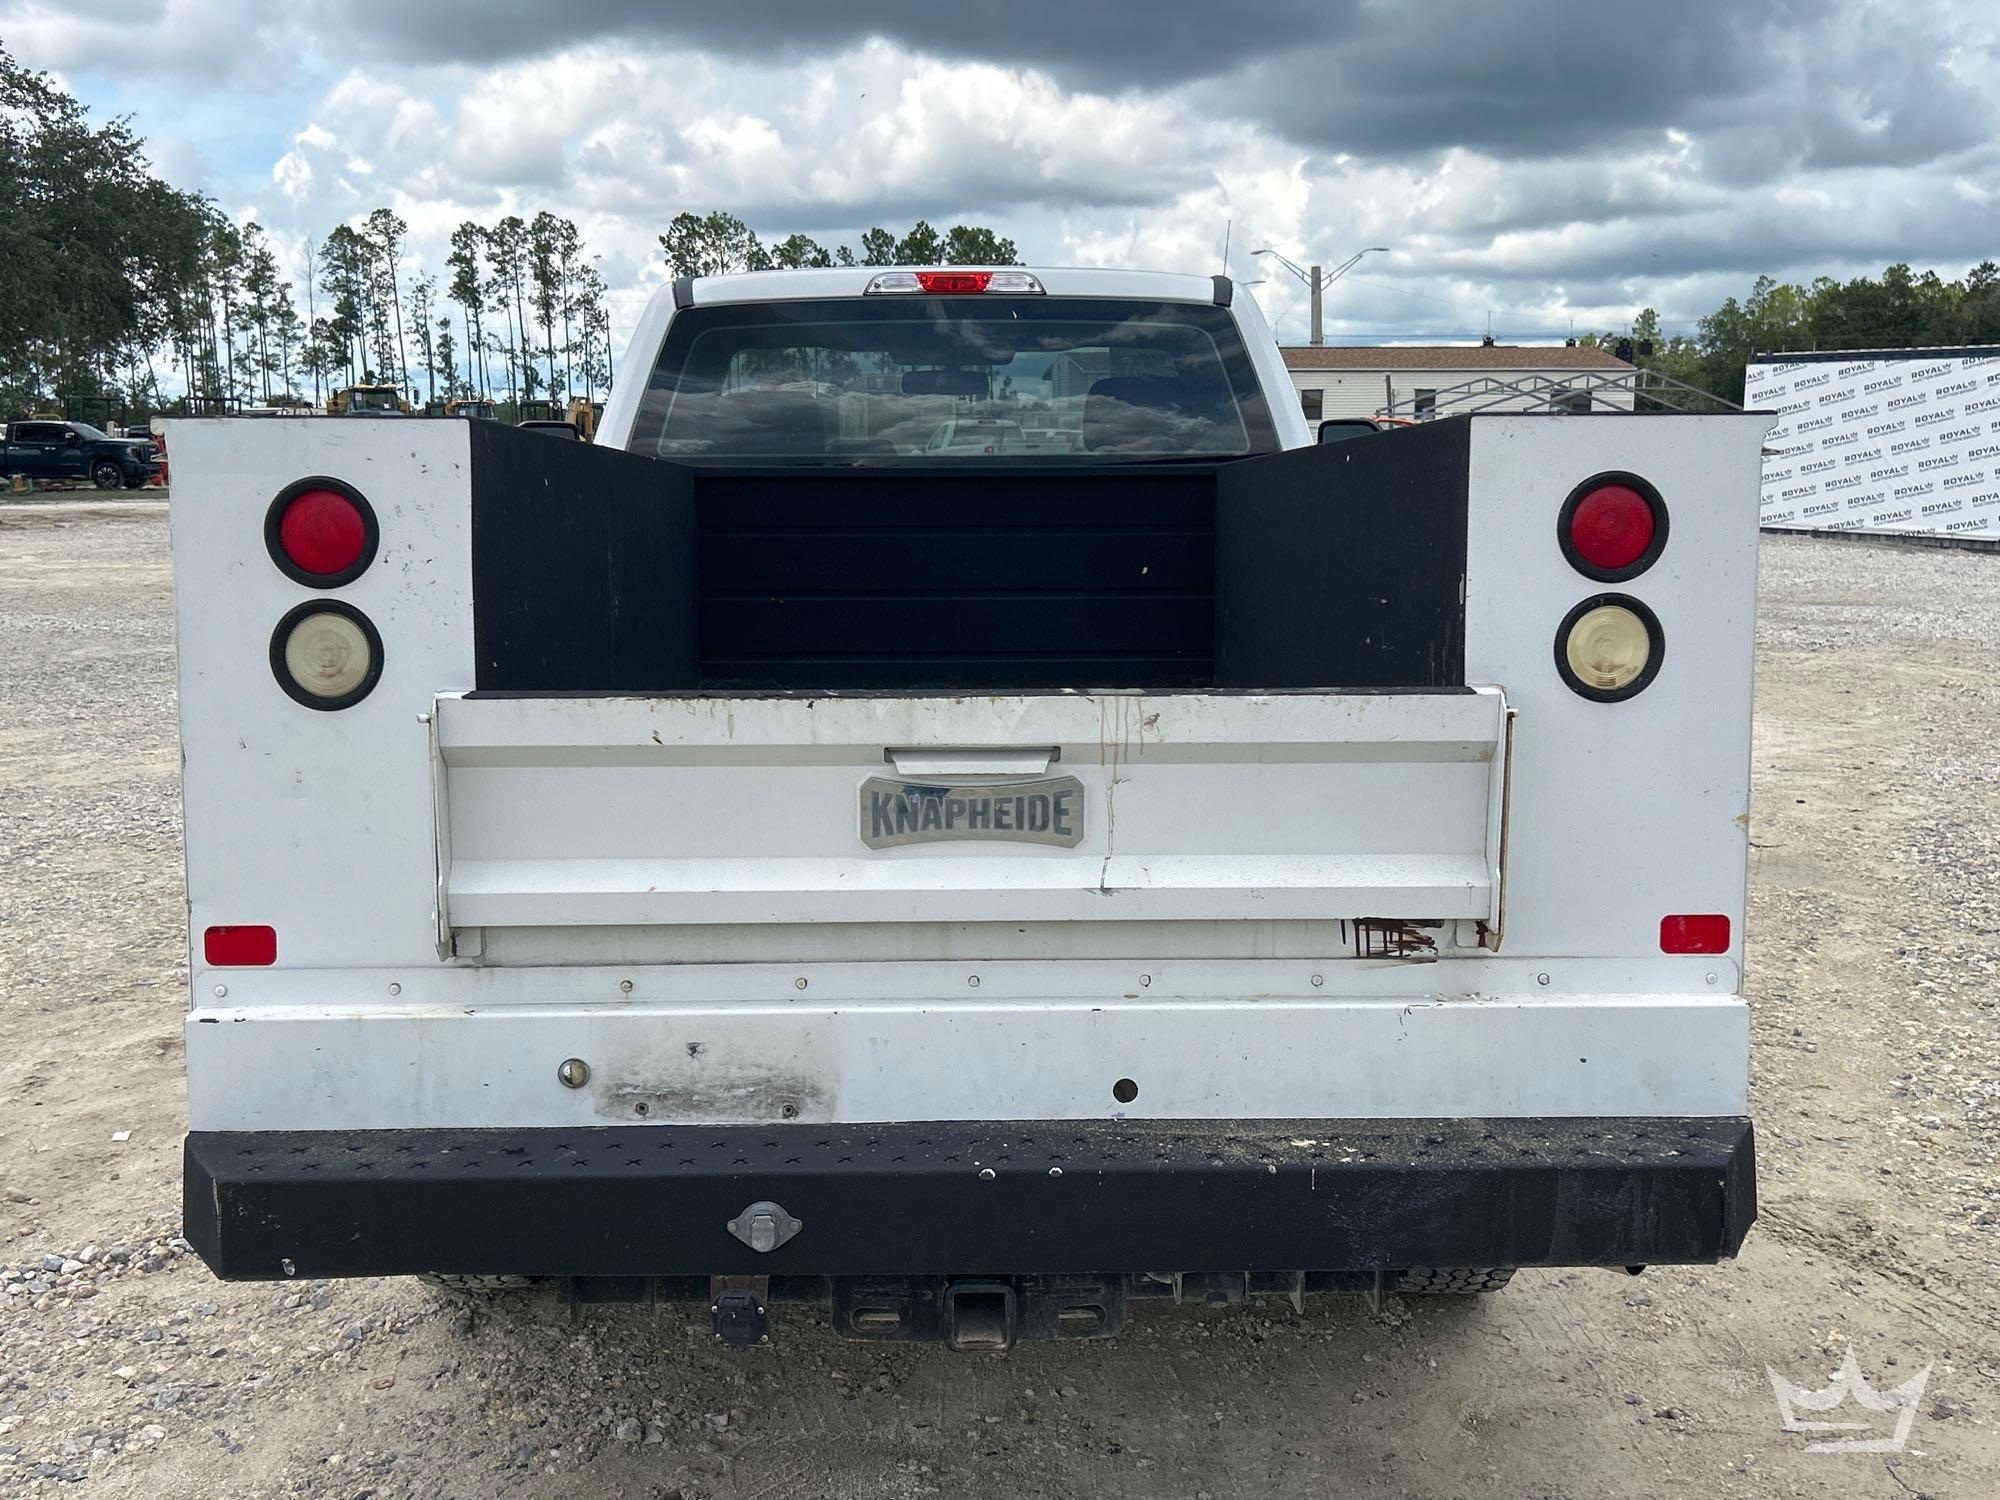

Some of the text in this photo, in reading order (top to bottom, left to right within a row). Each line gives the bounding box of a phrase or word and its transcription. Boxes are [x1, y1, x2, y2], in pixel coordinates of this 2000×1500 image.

[1838, 364, 1866, 376] ROYAL
[1911, 365, 1942, 378] ROYAL
[1794, 376, 1820, 388] ROYAL
[1864, 378, 1893, 390] ROYAL
[1752, 388, 1778, 400] ROYAL
[1936, 382, 1968, 395] ROYAL
[1819, 390, 1846, 402] ROYAL
[1888, 395, 1916, 407] ROYAL
[1965, 399, 1996, 411] ROYAL
[1842, 406, 1869, 419] ROYAL
[1915, 411, 1945, 423] ROYAL
[1798, 418, 1824, 430] ROYAL
[1867, 422, 1896, 434] ROYAL
[1822, 434, 1850, 445] ROYAL
[1940, 428, 1971, 440] ROYAL
[1891, 439, 1921, 452] ROYAL
[1845, 450, 1872, 462] ROYAL
[1918, 456, 1950, 468] ROYAL
[1801, 462, 1828, 472] ROYAL
[1871, 467, 1900, 478] ROYAL
[1825, 477, 1853, 488] ROYAL
[1944, 474, 1975, 486] ROYAL
[1782, 487, 1808, 497] ROYAL
[1894, 484, 1923, 496] ROYAL
[1848, 494, 1876, 505] ROYAL
[1803, 503, 1830, 514] ROYAL
[1922, 501, 1953, 512] ROYAL
[1761, 513, 1787, 522] ROYAL
[1874, 511, 1904, 522] ROYAL
[1947, 519, 1978, 530] ROYAL
[871, 790, 1072, 838] KNAPHEIDE
